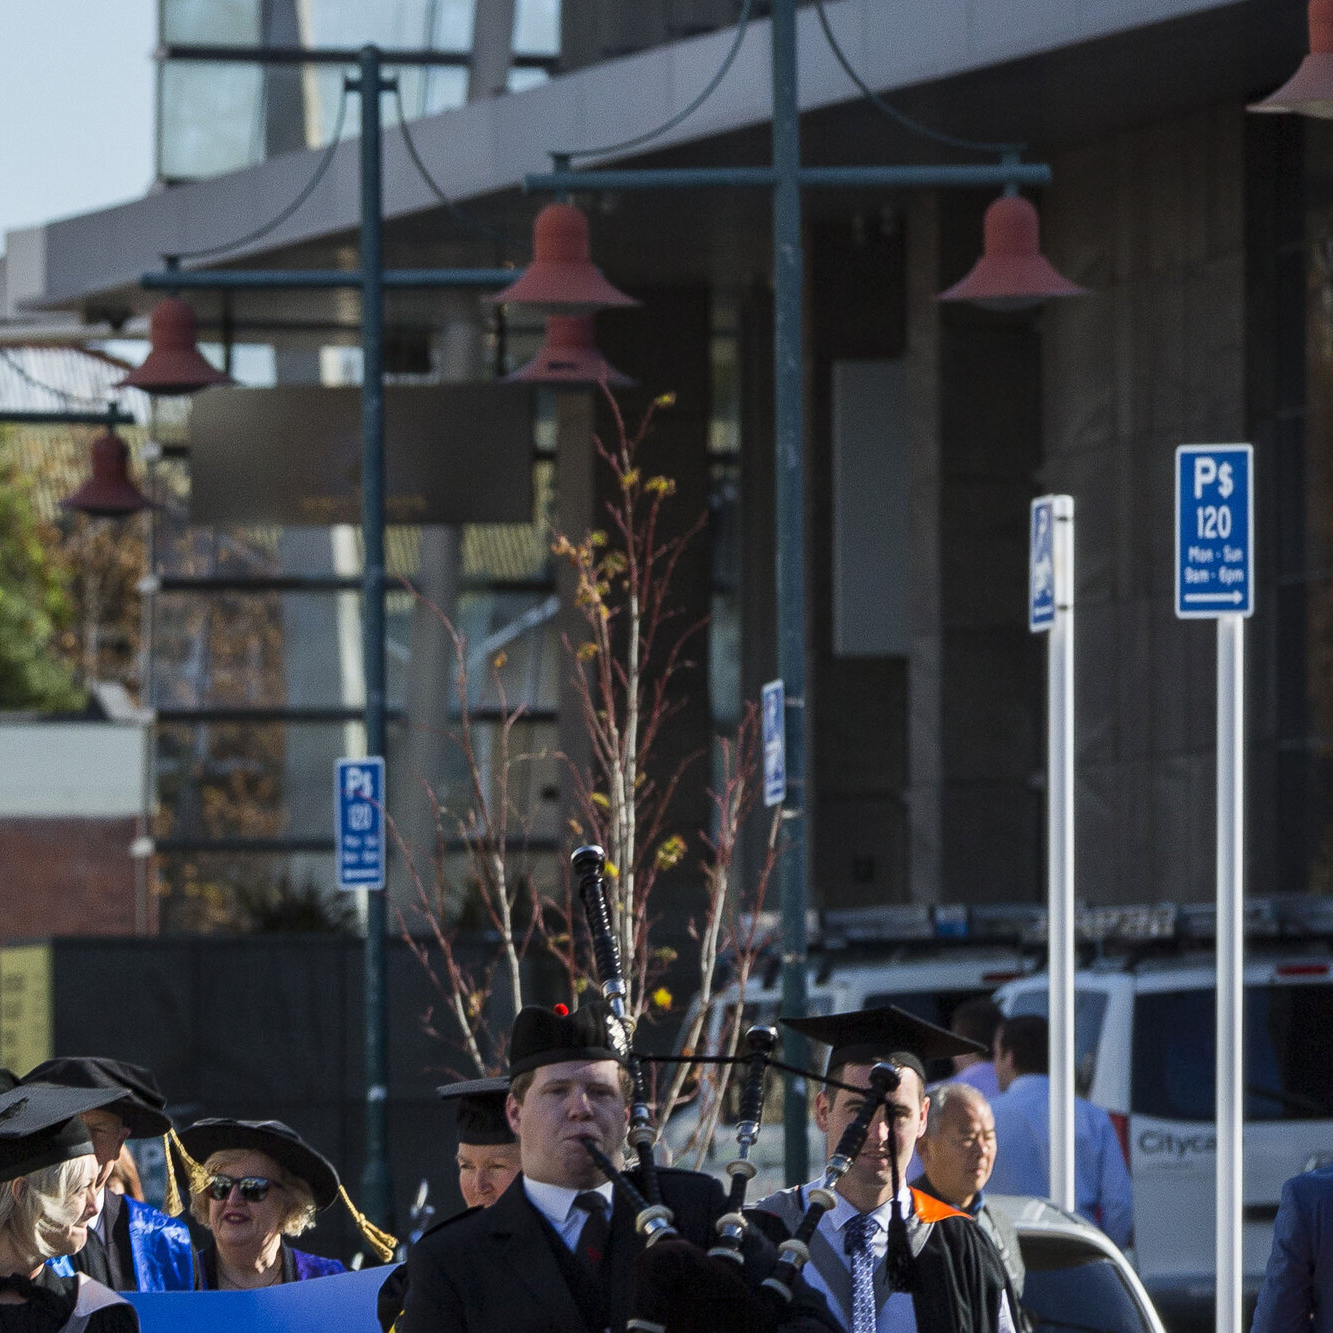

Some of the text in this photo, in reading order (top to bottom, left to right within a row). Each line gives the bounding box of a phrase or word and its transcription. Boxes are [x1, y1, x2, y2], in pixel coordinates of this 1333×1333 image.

[1194, 457, 1234, 499] P$
[1197, 505, 1232, 539] 120
[1188, 546, 1214, 563] Mon
[1223, 545, 1244, 563] Sun
